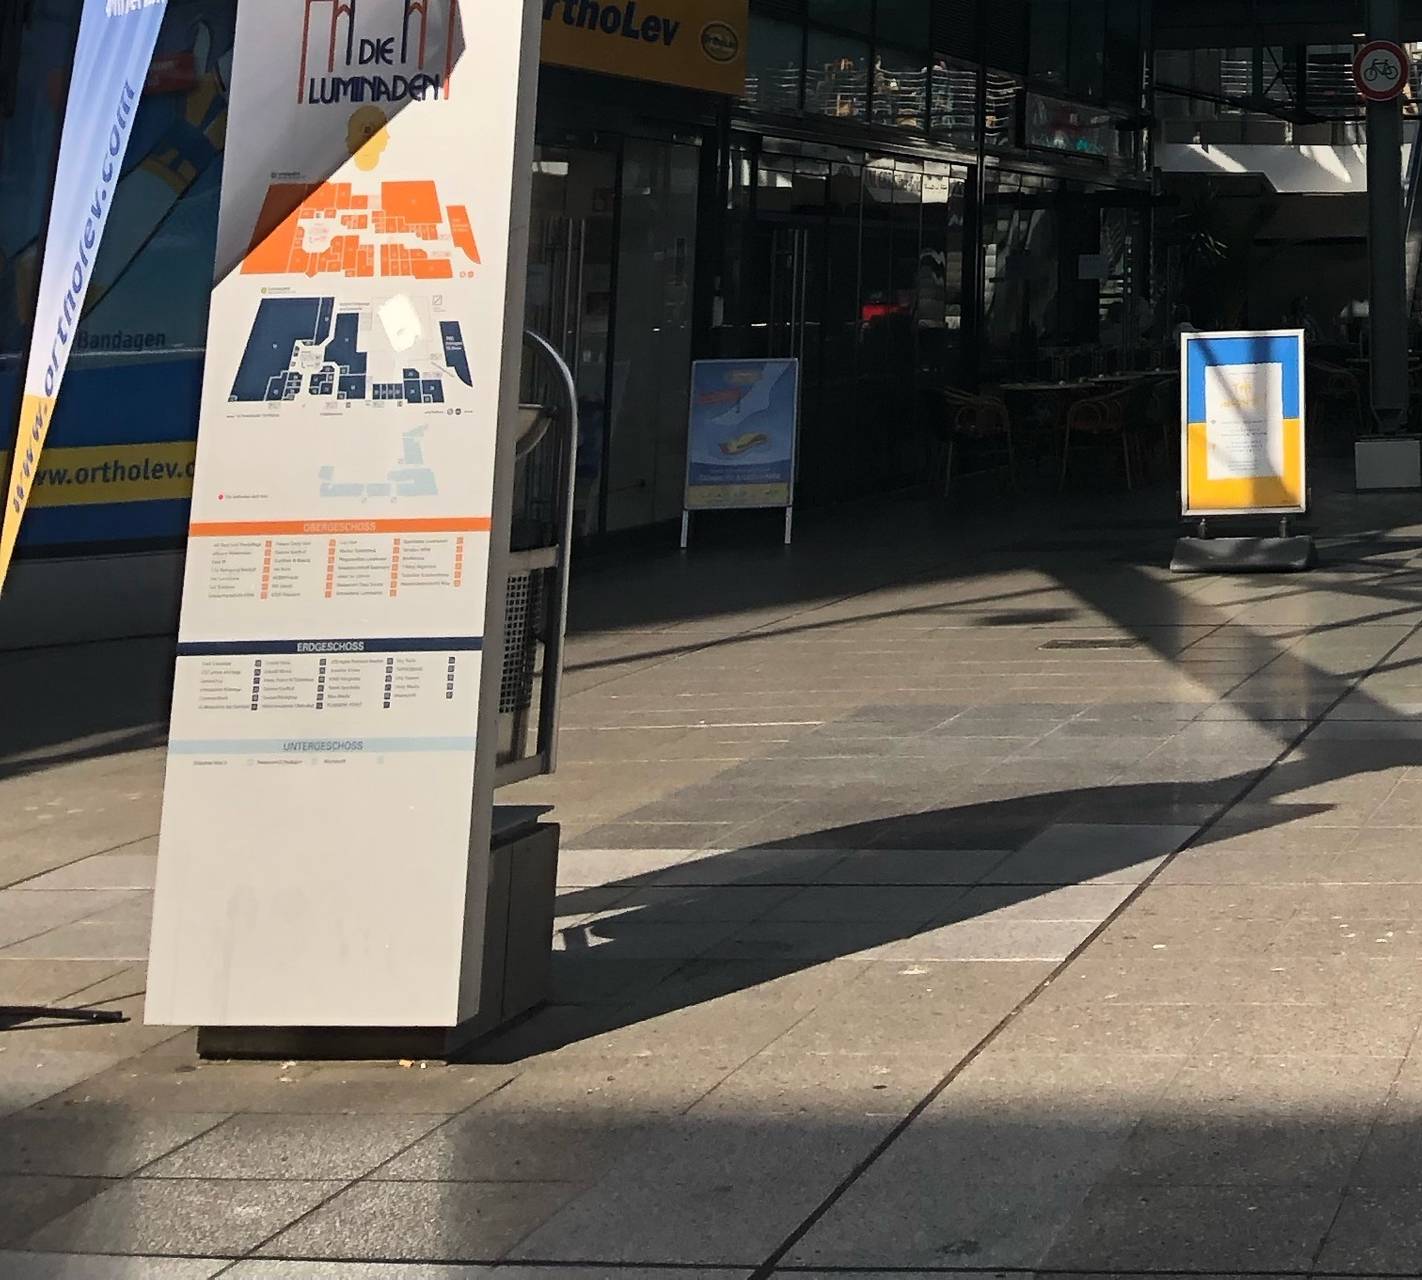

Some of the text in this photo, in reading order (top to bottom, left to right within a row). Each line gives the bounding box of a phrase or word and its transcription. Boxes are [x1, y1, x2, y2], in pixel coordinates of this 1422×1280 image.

[541, 0, 680, 46] rthoLev
[359, 37, 395, 65] DIE
[308, 73, 440, 105] LUMINADEN
[14, 80, 135, 513] www.ortholev.com
[77, 329, 166, 352] Bandagen
[296, 641, 365, 652] ERDGESCHOSS
[283, 740, 364, 752] UNTERGESCHOSS
